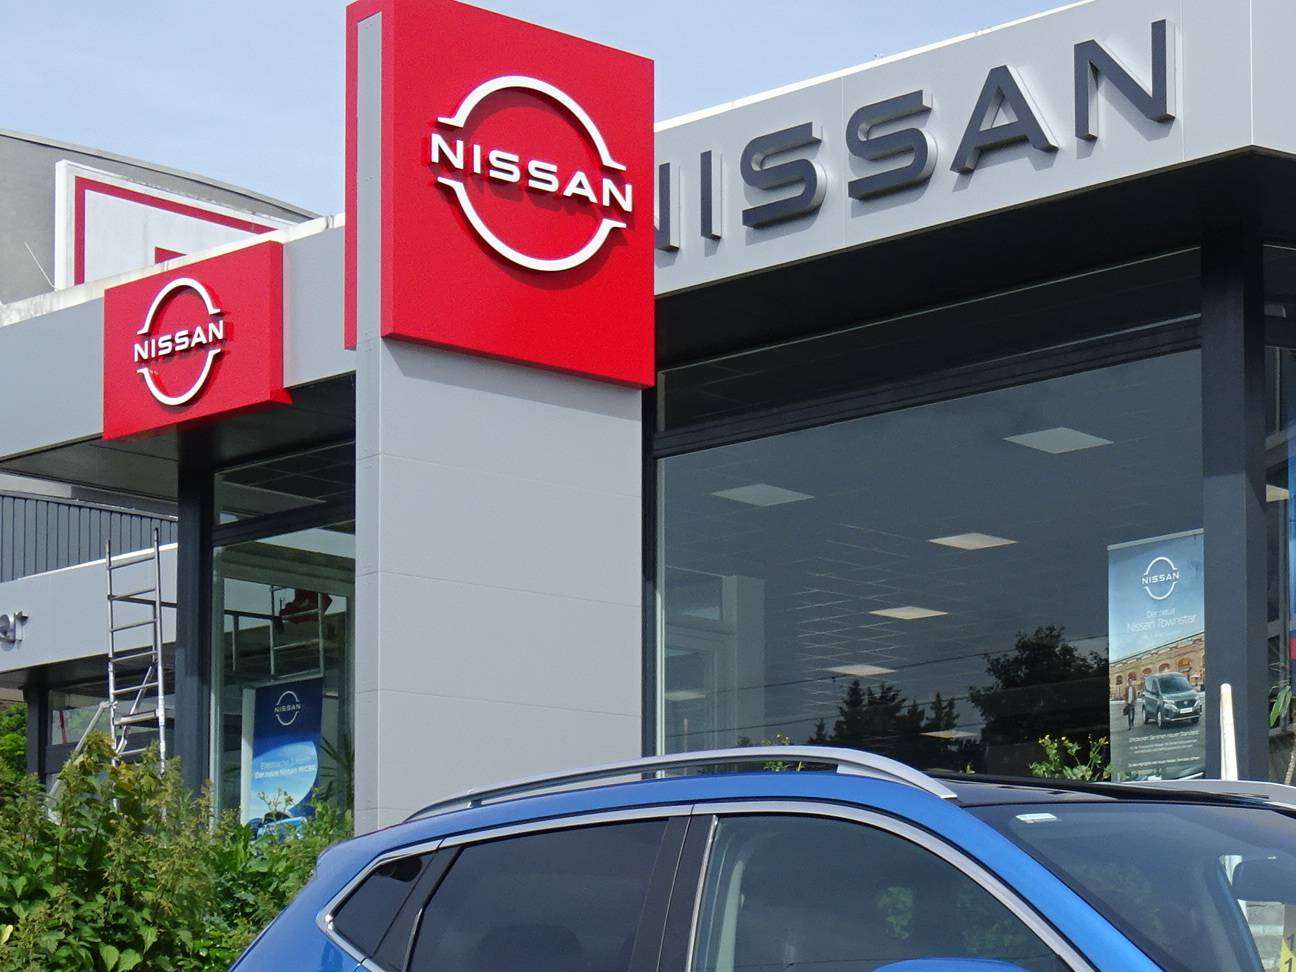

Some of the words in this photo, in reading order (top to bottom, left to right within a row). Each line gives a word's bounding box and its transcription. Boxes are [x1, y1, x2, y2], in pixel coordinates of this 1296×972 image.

[431, 132, 633, 212] NISSAN
[134, 320, 224, 362] NISSAN
[1141, 571, 1180, 585] NISSAN
